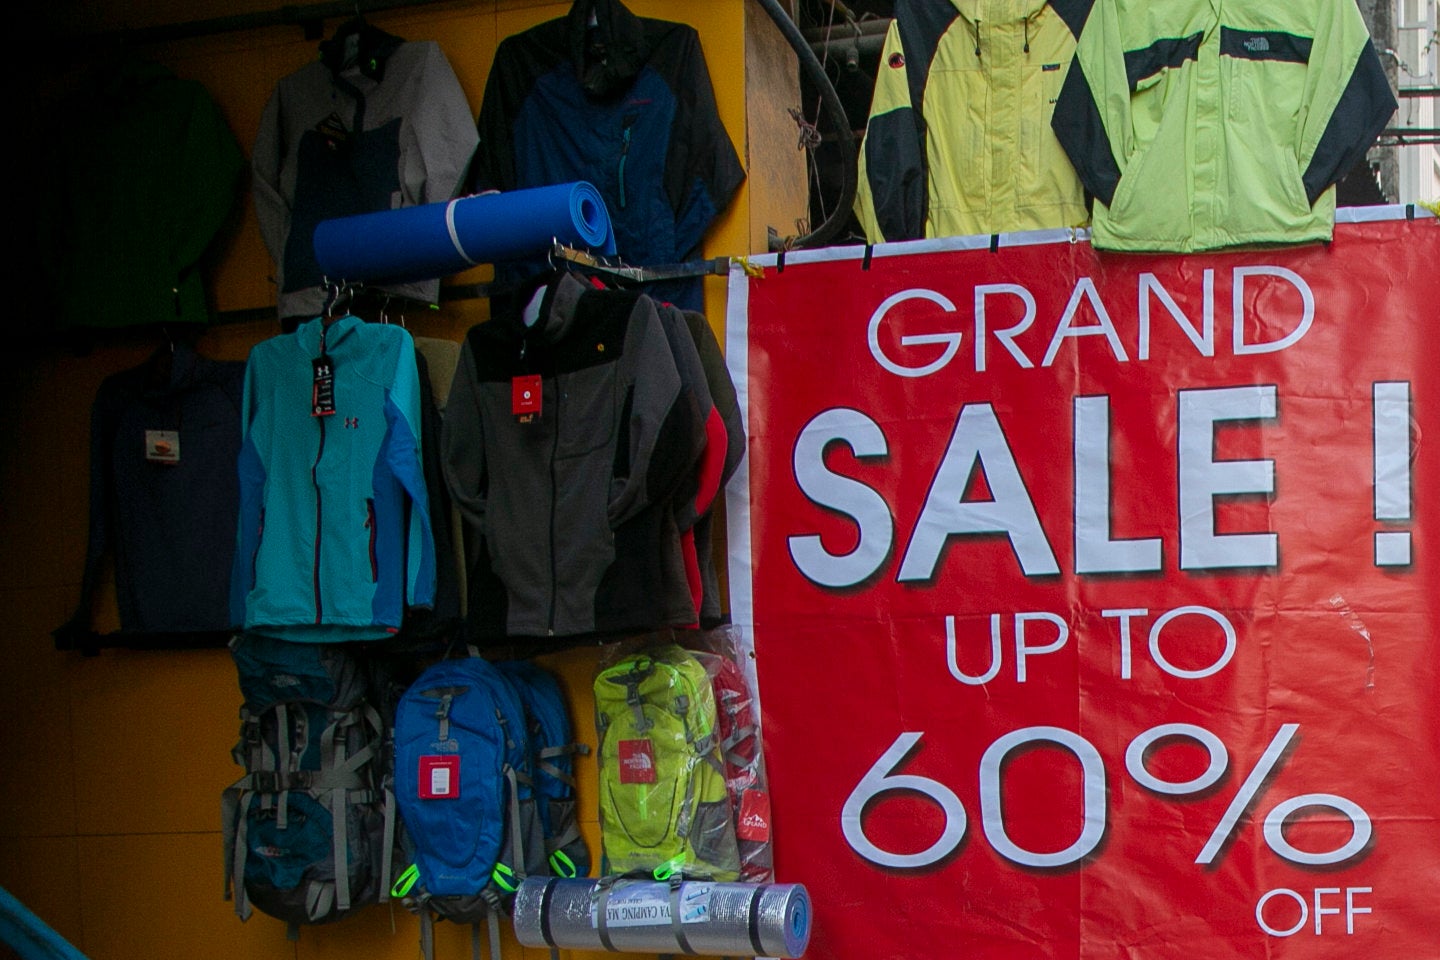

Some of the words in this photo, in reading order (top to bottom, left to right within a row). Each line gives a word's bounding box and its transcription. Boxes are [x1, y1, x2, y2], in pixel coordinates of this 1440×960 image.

[867, 264, 1316, 378] GRAND
[788, 384, 1280, 586] SALE
[945, 612, 1070, 686] UP
[1102, 605, 1237, 680] TO
[841, 722, 1373, 867] 60%
[621, 905, 658, 921] CAMPING
[1254, 886, 1373, 937] OFF
